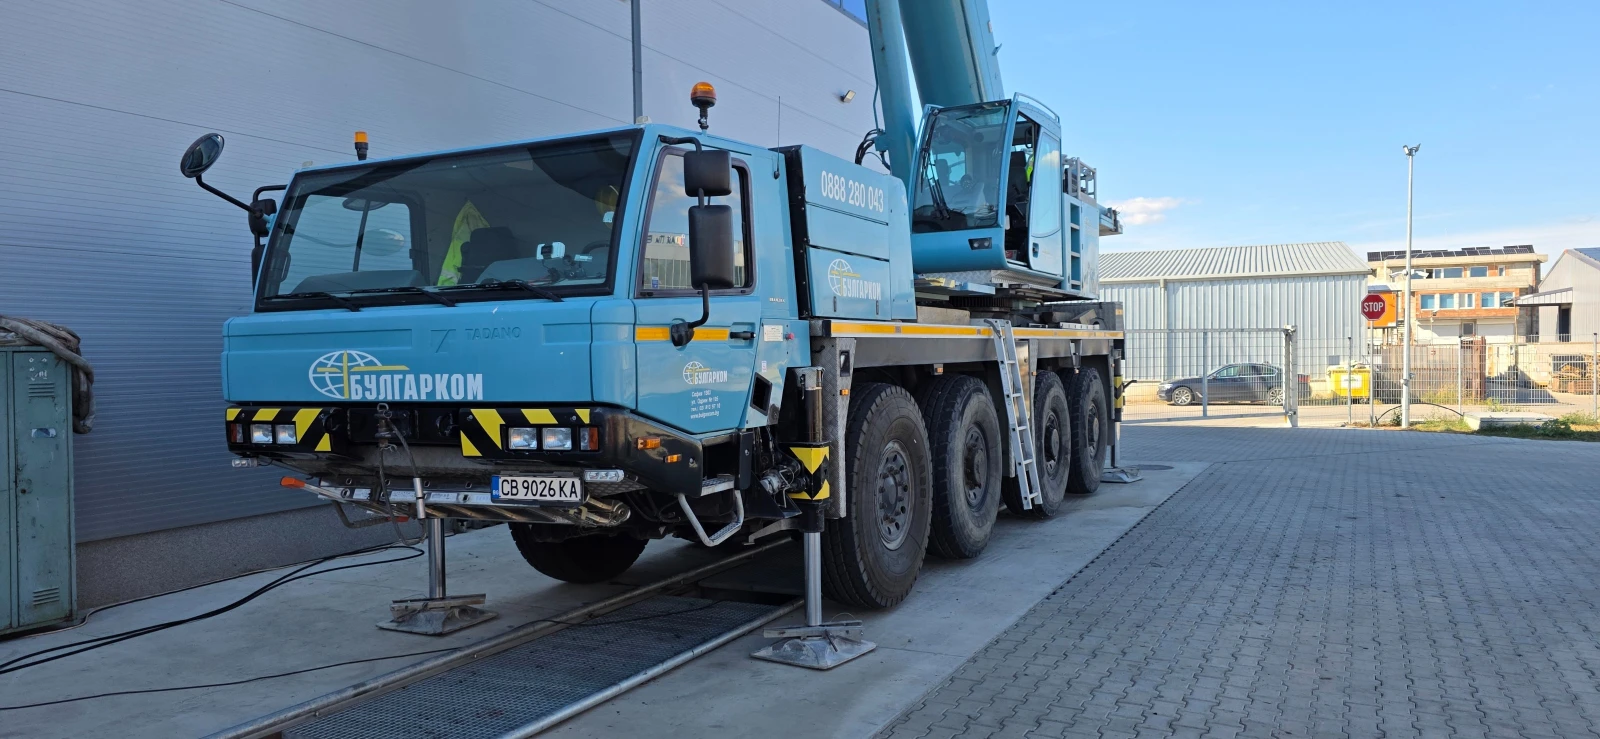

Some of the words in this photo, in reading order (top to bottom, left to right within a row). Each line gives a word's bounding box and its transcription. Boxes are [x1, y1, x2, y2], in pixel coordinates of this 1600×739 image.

[821, 170, 846, 203] 0888
[848, 179, 866, 208] 280
[868, 186, 884, 213] 043
[842, 277, 882, 301] БУЛГАРКОМ
[1363, 302, 1384, 312] STOP
[465, 326, 522, 340] TADANO
[350, 373, 483, 400] БУЛГАРКОМ
[694, 370, 728, 384] БУЛГАРКОМ
[501, 479, 519, 497] CB
[521, 479, 557, 498] 9026
[559, 480, 578, 499] KA
